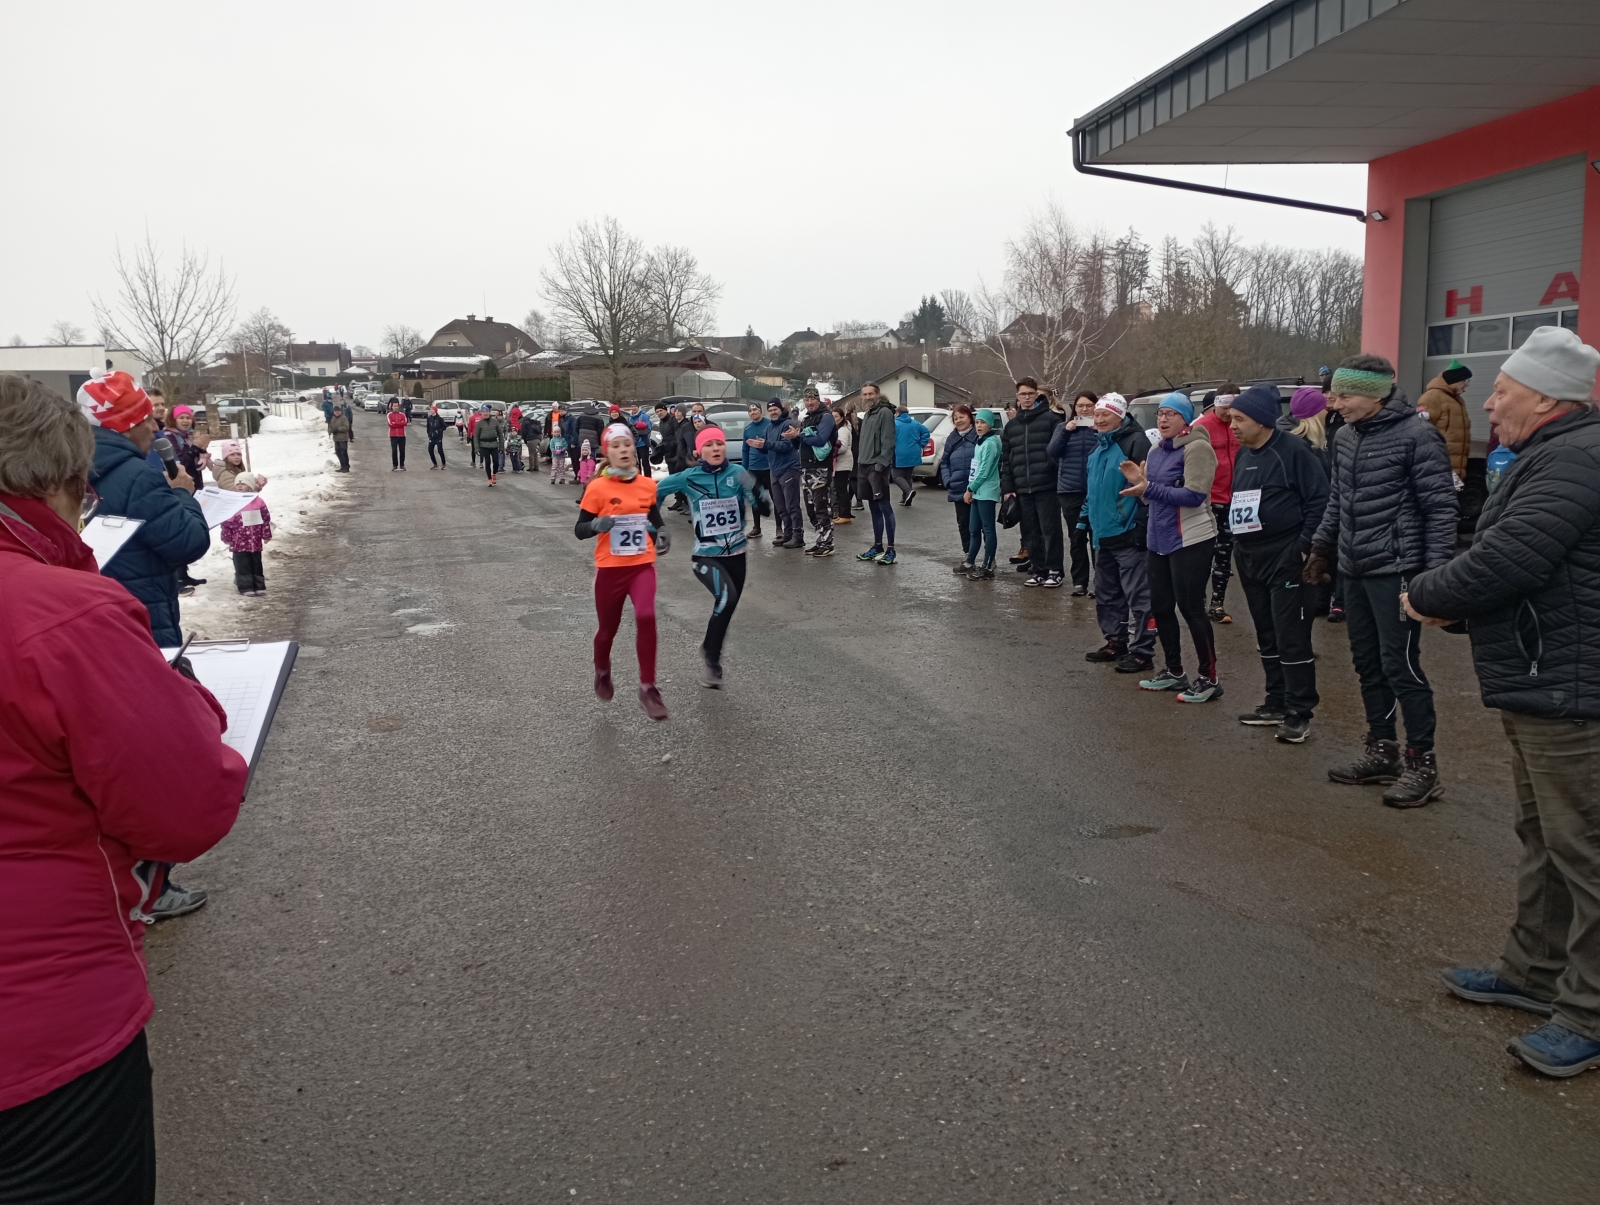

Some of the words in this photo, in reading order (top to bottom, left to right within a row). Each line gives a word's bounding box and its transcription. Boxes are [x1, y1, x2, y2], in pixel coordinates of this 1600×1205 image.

[705, 510, 738, 528] 263
[1232, 506, 1254, 525] 132
[620, 530, 643, 546] 26
